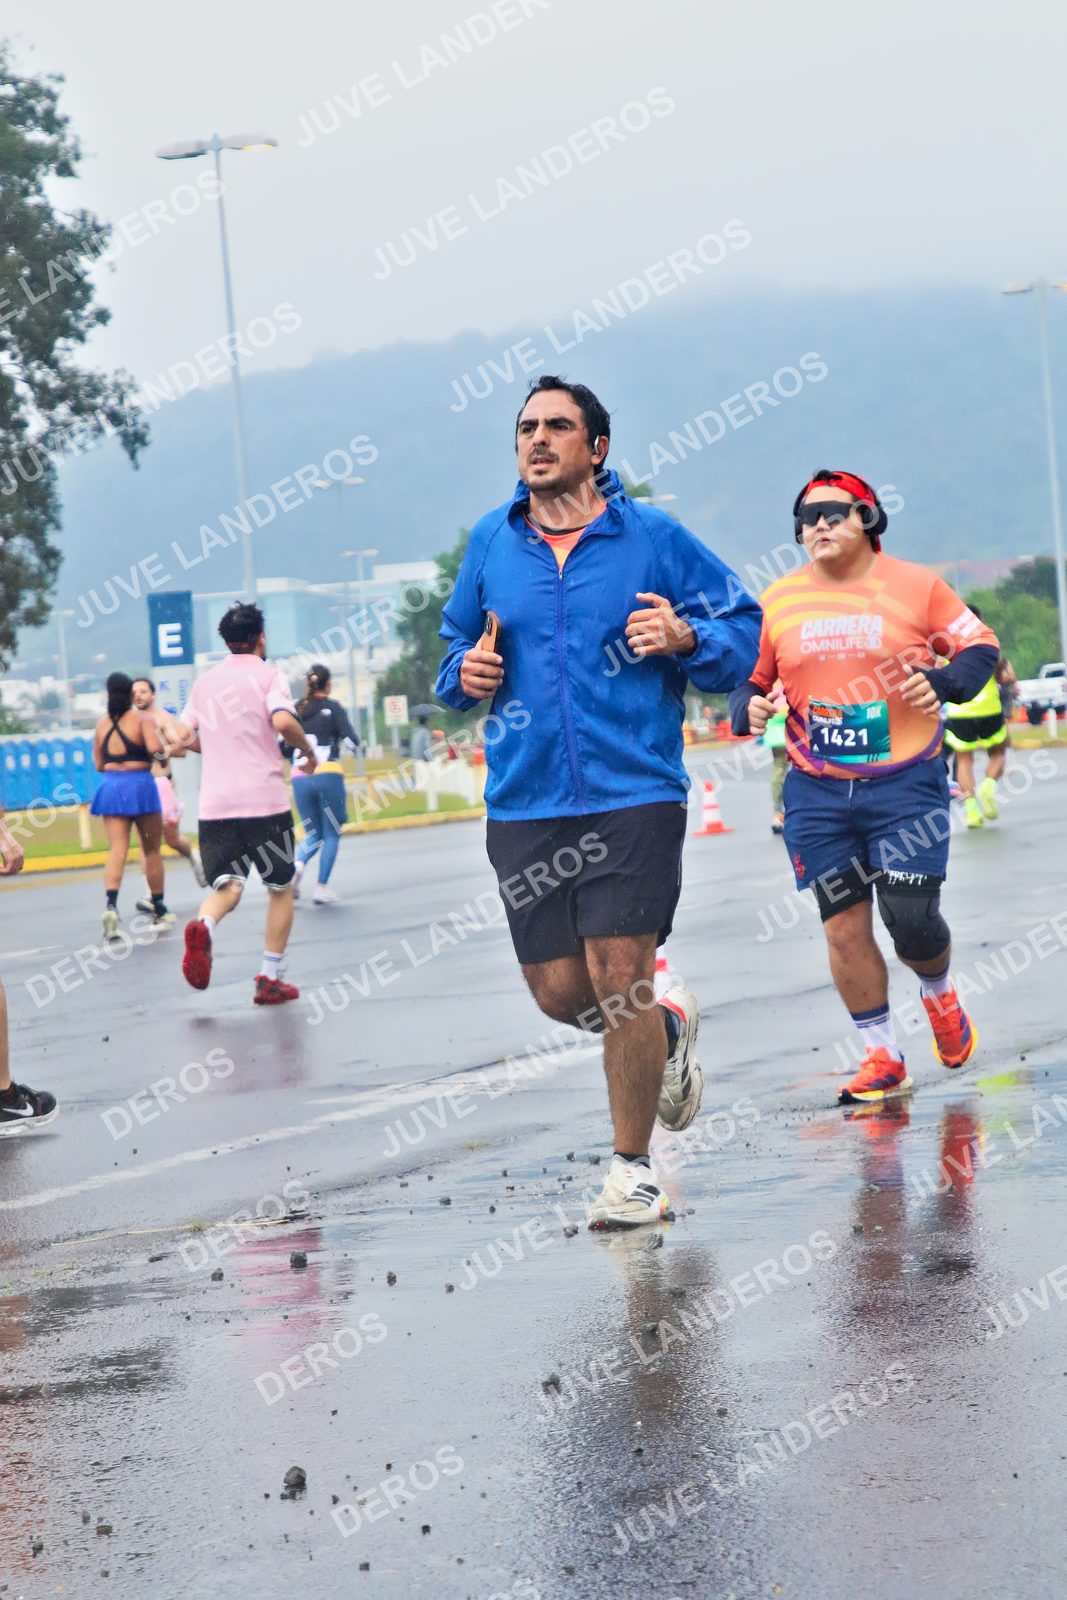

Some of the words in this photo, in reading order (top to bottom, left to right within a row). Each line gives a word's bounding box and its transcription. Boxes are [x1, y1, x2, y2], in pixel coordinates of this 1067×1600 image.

[157, 622, 184, 658] E
[800, 614, 883, 640] CARRERA
[820, 727, 868, 747] 1421
